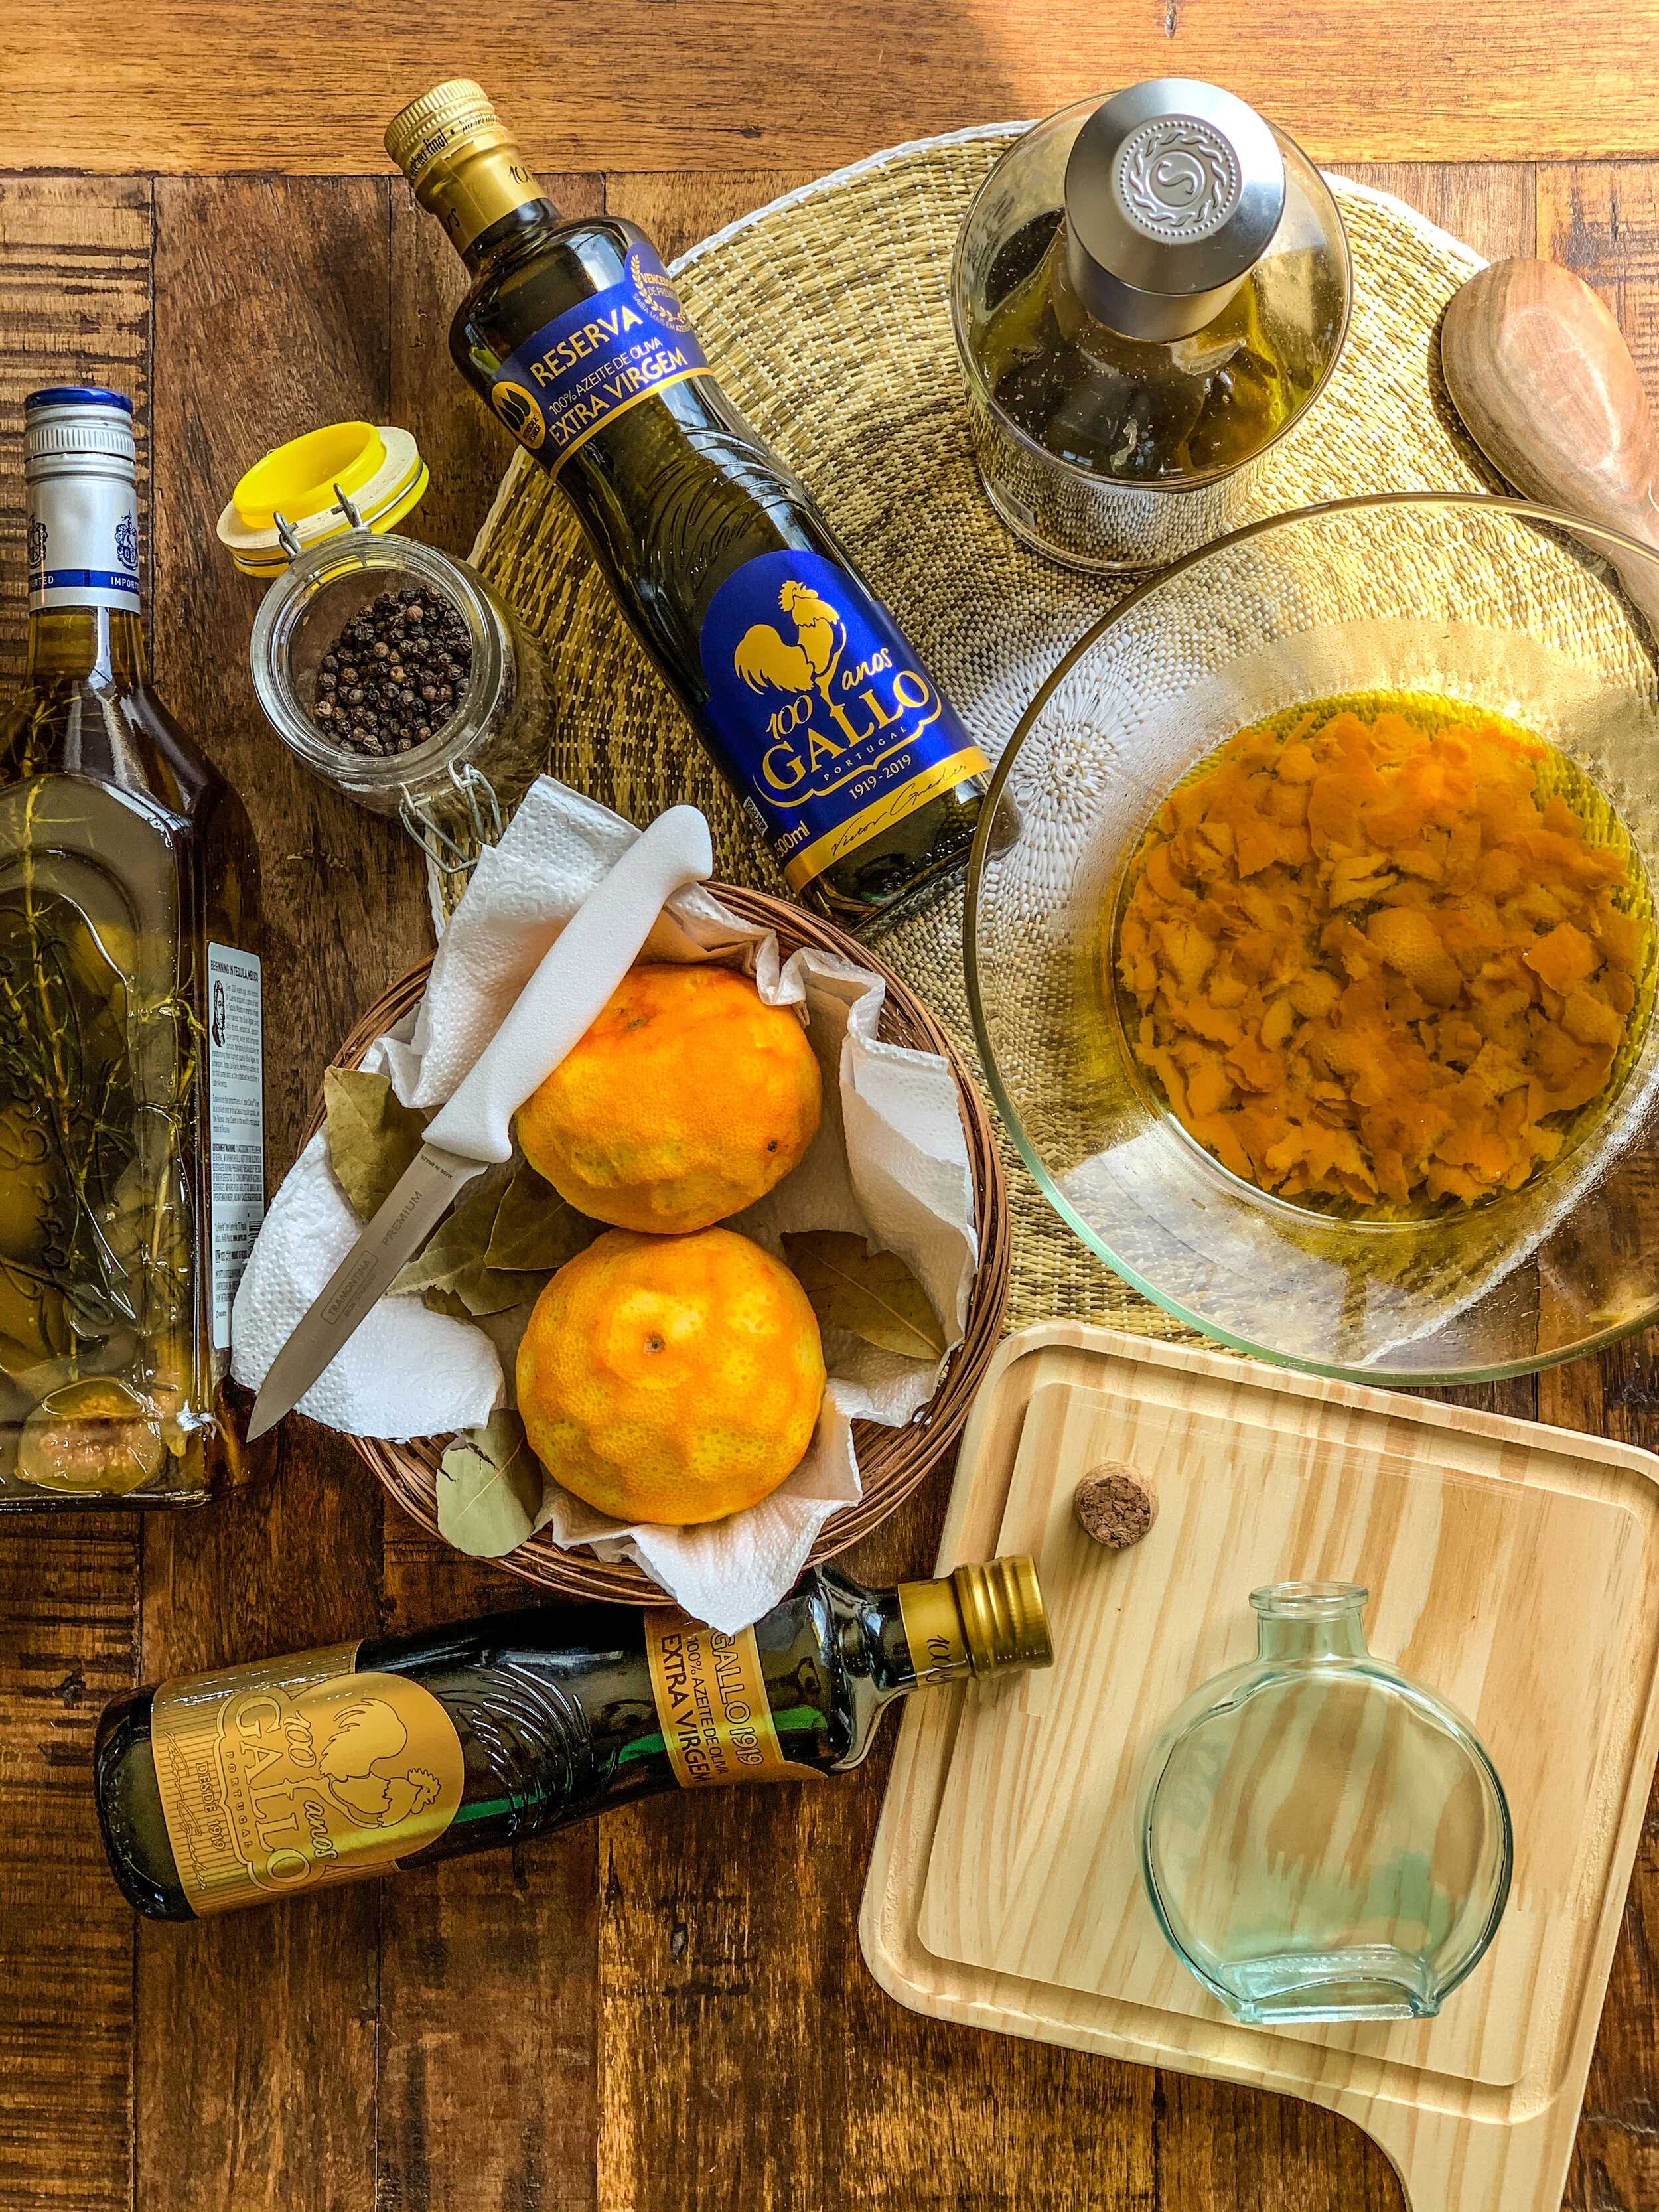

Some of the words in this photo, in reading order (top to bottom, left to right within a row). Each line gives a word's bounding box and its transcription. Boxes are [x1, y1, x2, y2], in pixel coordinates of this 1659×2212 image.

[423, 128, 448, 155] final
[530, 305, 644, 388] RESERVA
[632, 293, 648, 314] SAIBA
[649, 312, 664, 326] MAIS
[548, 394, 611, 447] EXTRA
[602, 346, 689, 399] VIRGEM
[549, 390, 577, 415] 100%
[575, 362, 616, 396] AZEITE
[612, 352, 632, 370] DE
[629, 336, 664, 359] OLIVA
[762, 670, 930, 790] GALLO
[765, 694, 813, 740] 100
[841, 647, 893, 691] anos
[823, 726, 907, 781] PORTUGAL
[381, 1191, 423, 1246] PREMIUM
[327, 1260, 372, 1315] TRAMONTINA
[661, 1633, 690, 1710] EXTRA
[686, 1637, 703, 1676] 100%
[710, 1629, 751, 1725] GALLO
[691, 1678, 715, 1728] AZEITE
[701, 1728, 720, 1746] DE
[674, 1710, 713, 1783] VIRGEM
[708, 1746, 729, 1775] OLIVA
[729, 1726, 764, 1766] 1919
[196, 1760, 217, 1813] DESDE
[207, 1818, 226, 1850] 1919
[225, 1750, 253, 1850] PORTUGAL
[235, 1694, 311, 1883] GALLO
[283, 1710, 317, 1769] 100
[303, 1799, 339, 1860] anos
